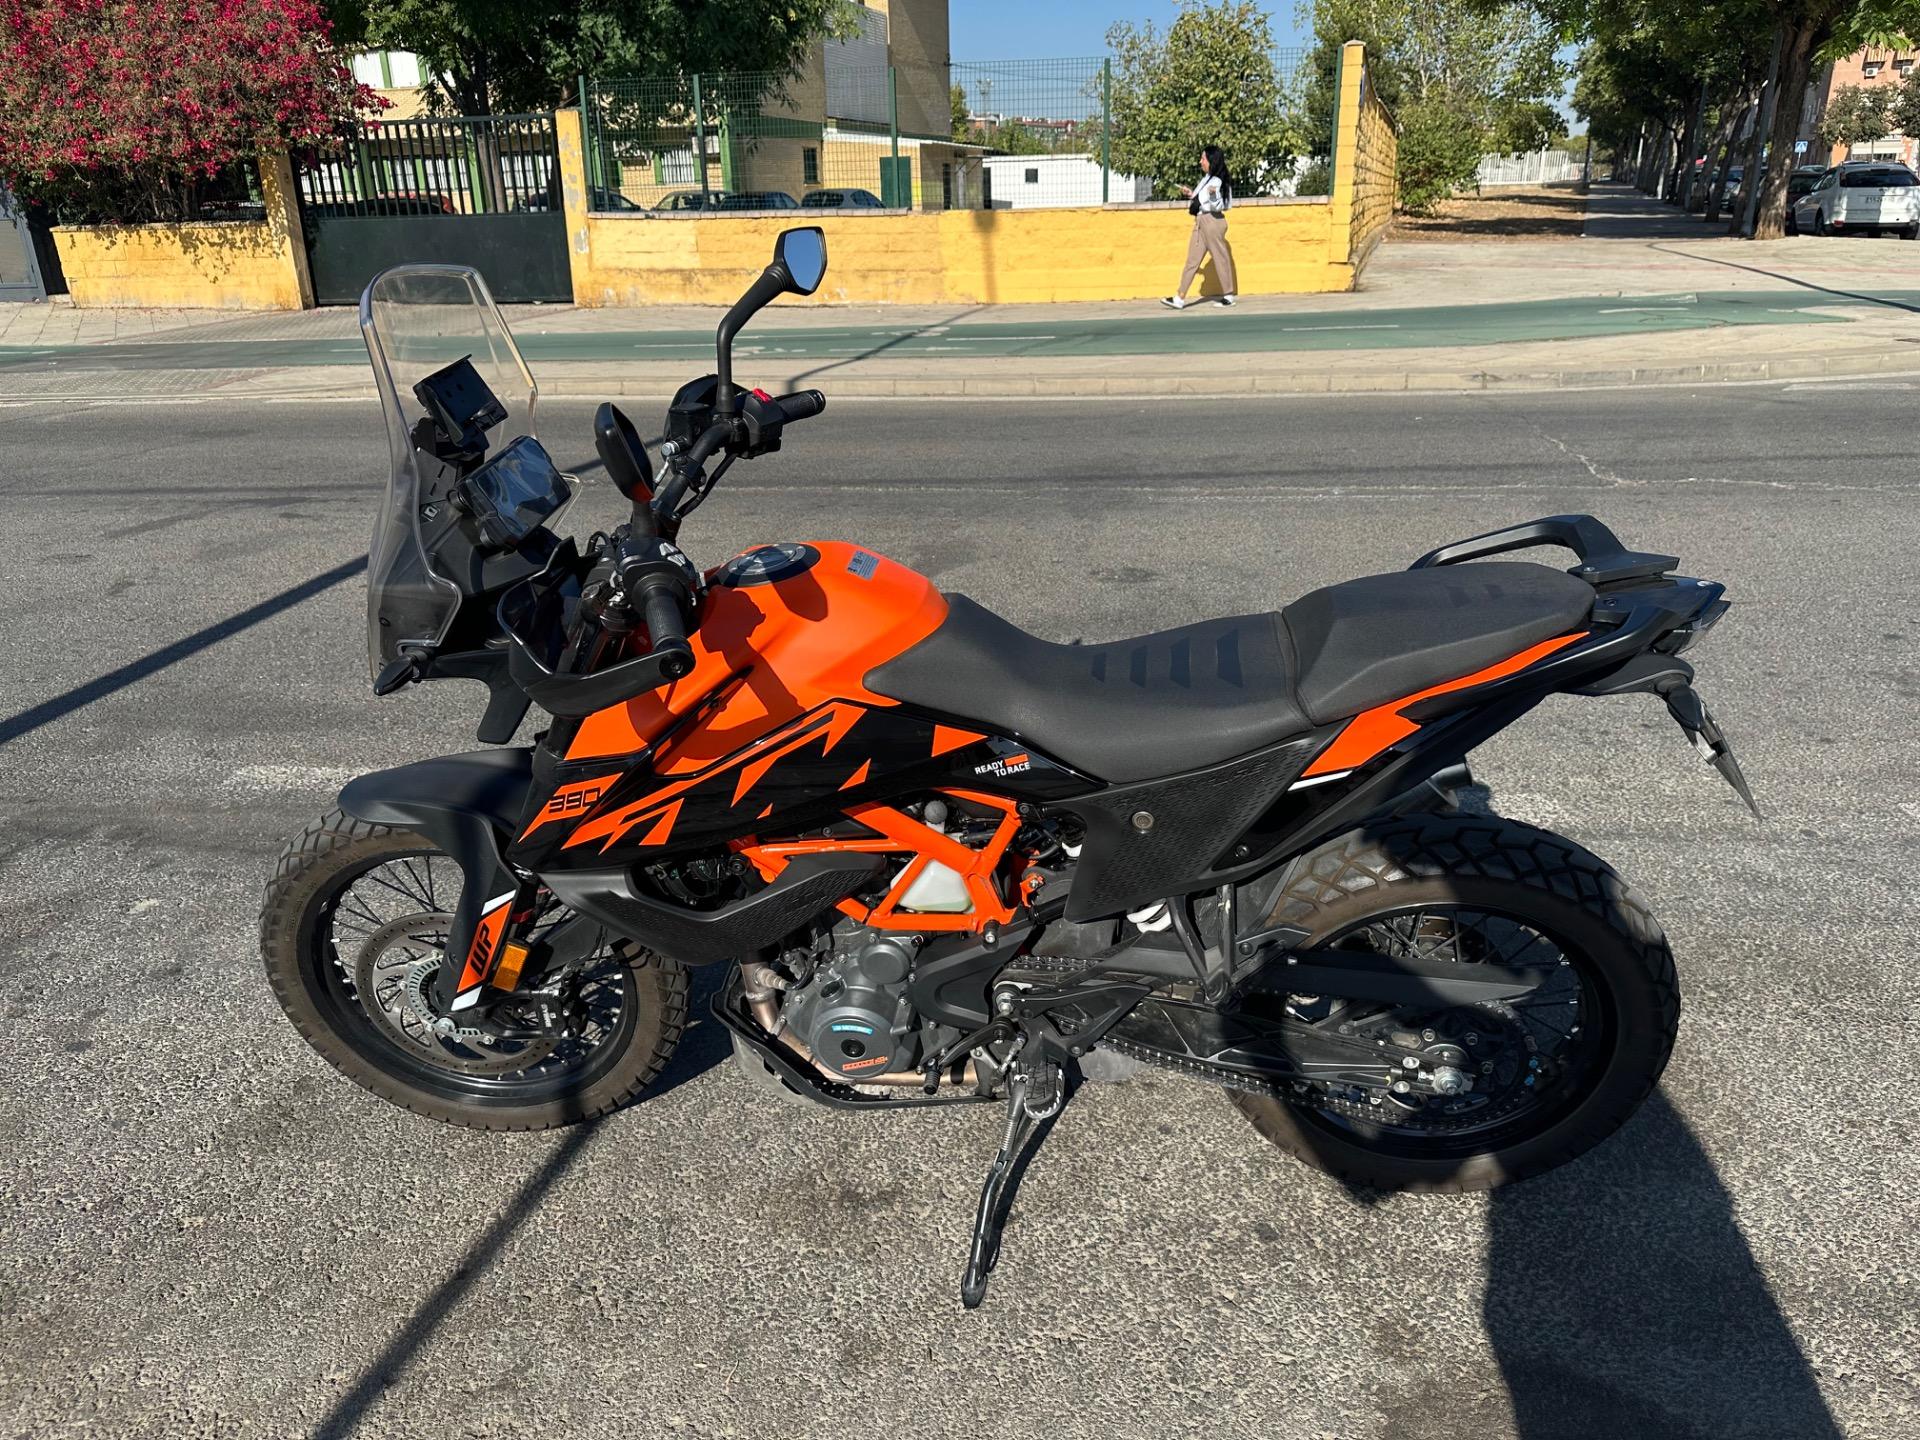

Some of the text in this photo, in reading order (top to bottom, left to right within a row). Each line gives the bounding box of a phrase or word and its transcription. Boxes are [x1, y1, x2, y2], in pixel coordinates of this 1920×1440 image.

[974, 760, 1004, 775] READY
[994, 762, 1031, 777] TO RACE
[548, 786, 601, 814] 390
